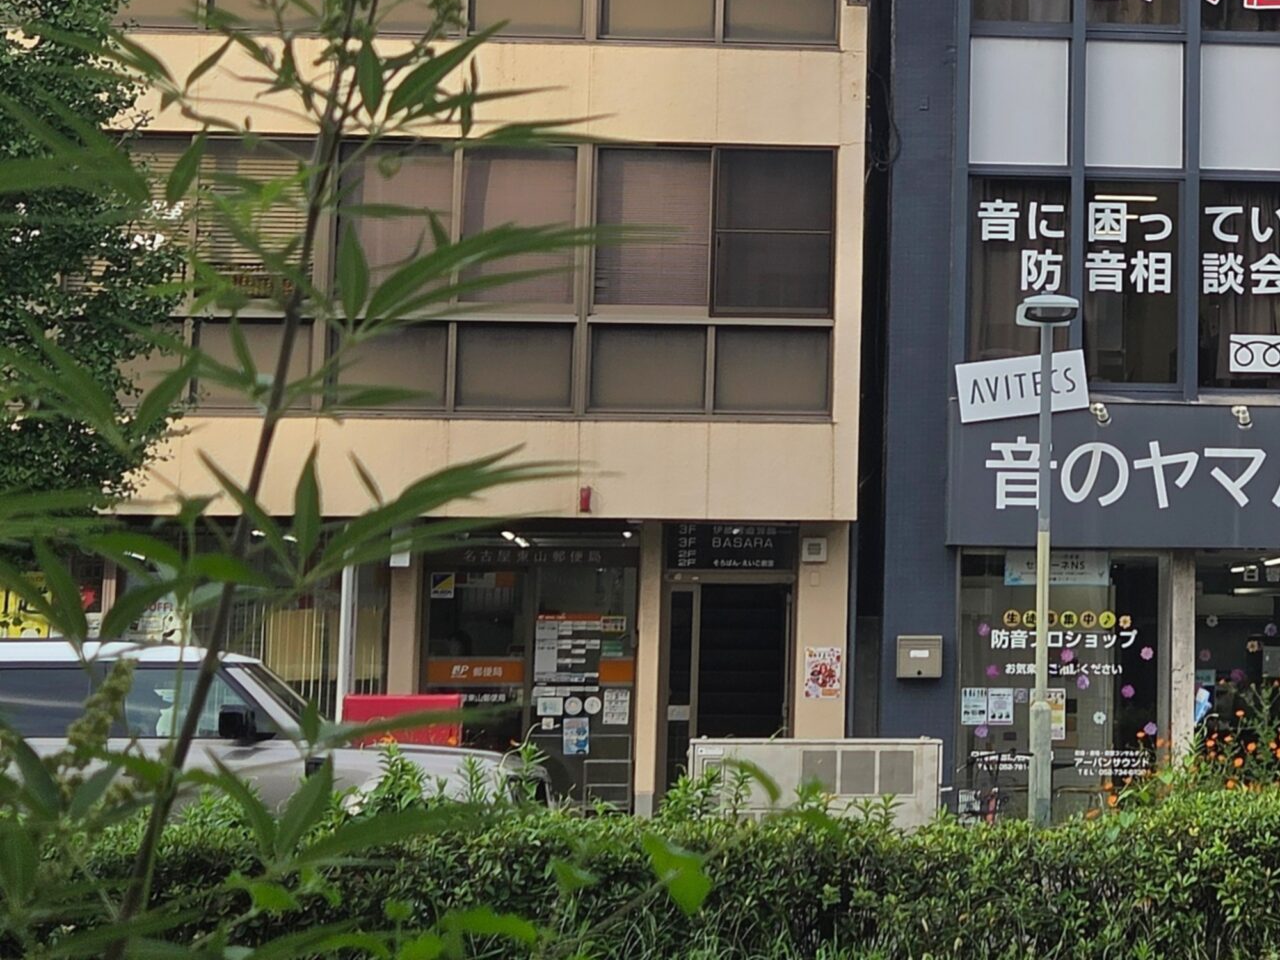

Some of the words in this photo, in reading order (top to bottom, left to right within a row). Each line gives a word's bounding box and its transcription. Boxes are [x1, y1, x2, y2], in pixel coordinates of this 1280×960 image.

[970, 367, 1077, 405] AVITECS
[678, 537, 697, 548] 3F
[711, 536, 774, 549] BASARA
[463, 549, 603, 563] 名古屋東山郵便局
